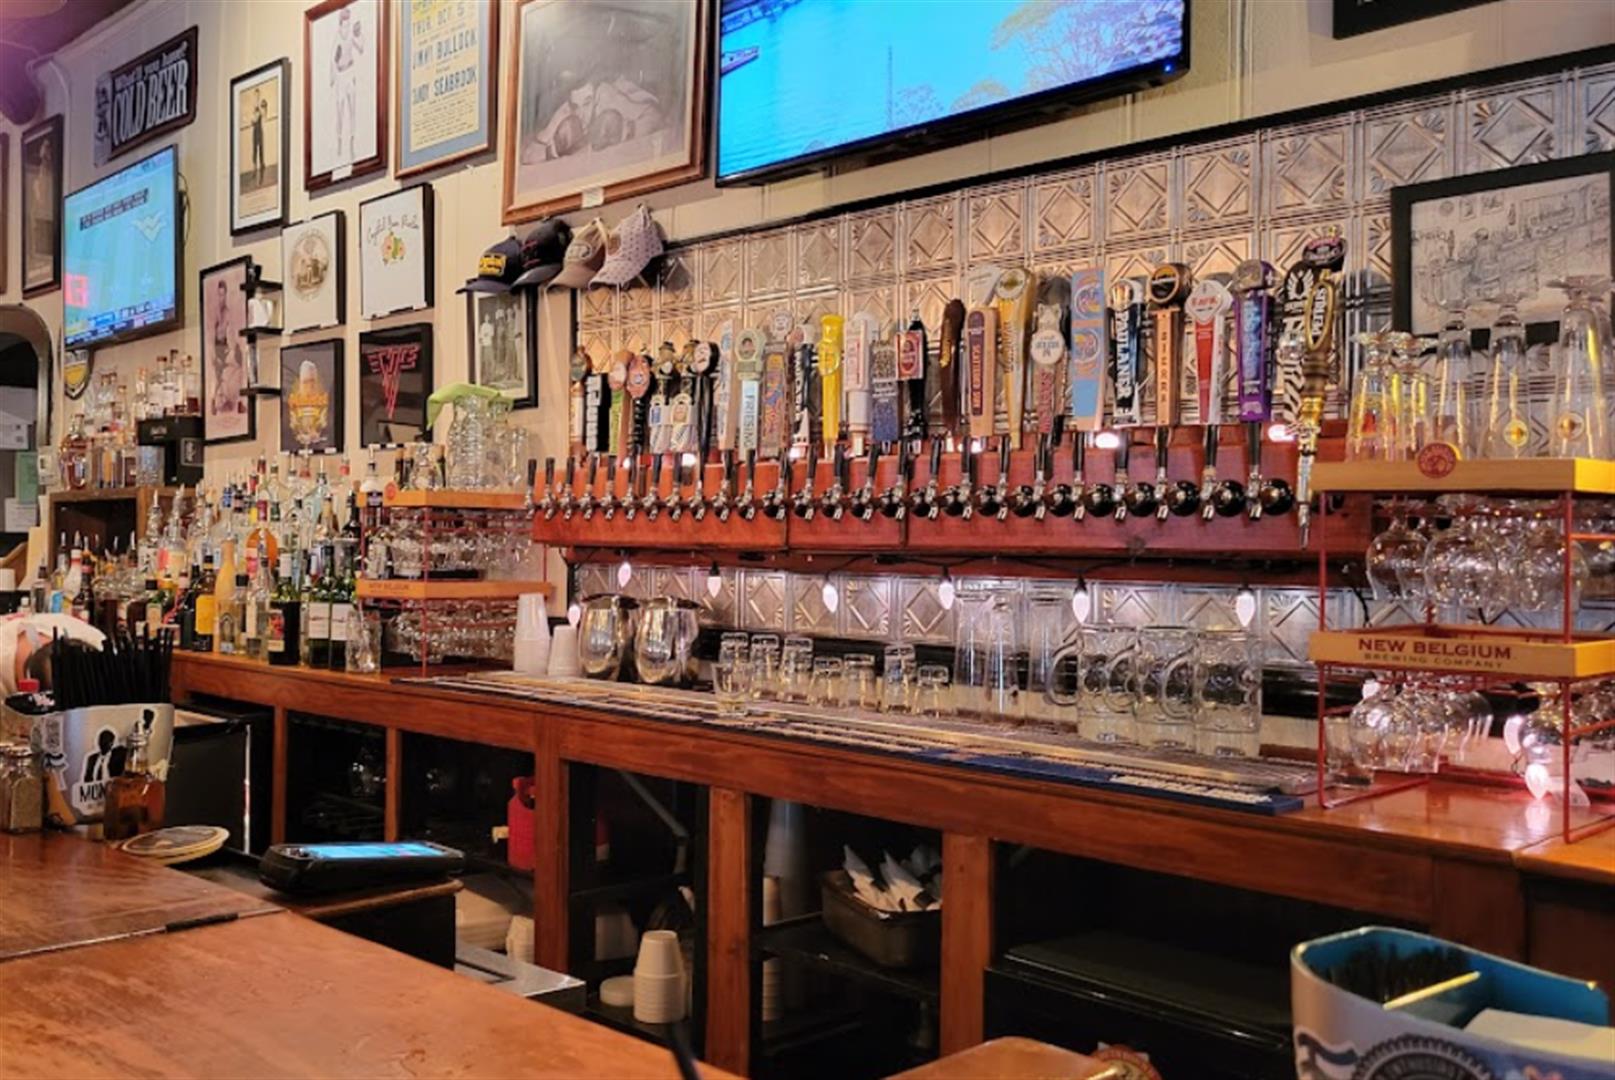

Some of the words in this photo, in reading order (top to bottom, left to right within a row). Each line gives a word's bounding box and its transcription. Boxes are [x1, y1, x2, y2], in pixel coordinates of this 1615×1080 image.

[436, 28, 478, 60] BULLOCK
[434, 65, 477, 97] SEABROOK
[113, 81, 146, 146] COLD
[145, 59, 188, 131] BEER
[1311, 287, 1327, 338] PETRUS
[1113, 312, 1133, 400] PAULANER
[1358, 638, 1406, 652] NEW
[1413, 641, 1511, 660] BELGIUM
[1364, 653, 1429, 664] BREWING
[1434, 657, 1503, 669] COMPANY
[80, 781, 107, 802] MUN
